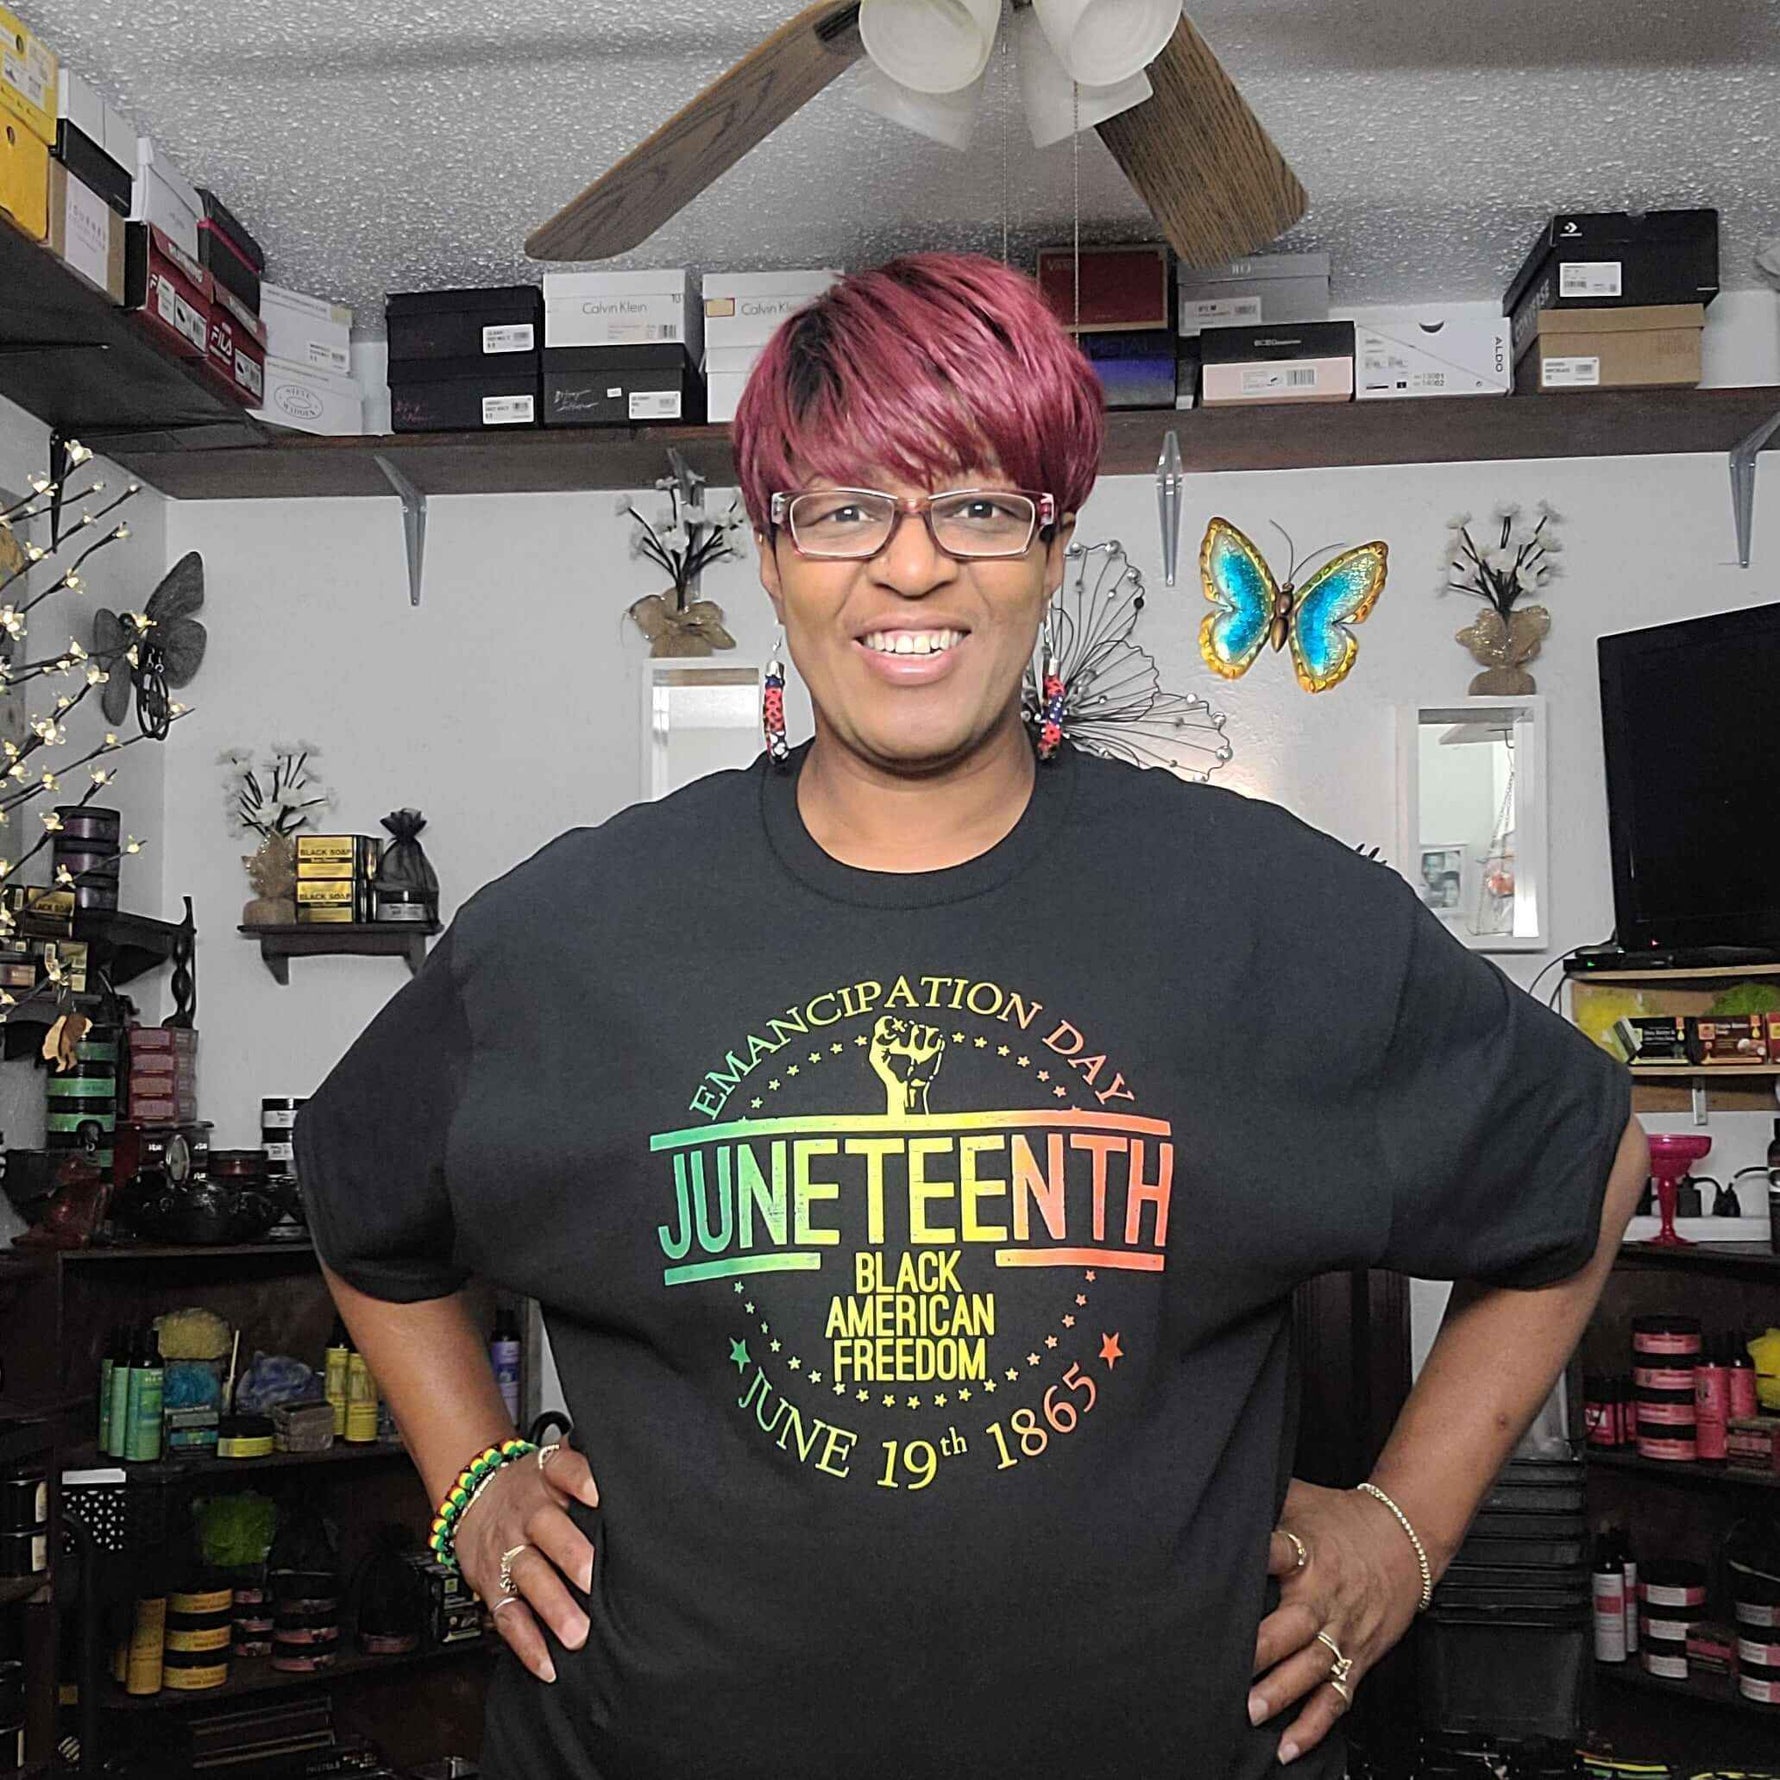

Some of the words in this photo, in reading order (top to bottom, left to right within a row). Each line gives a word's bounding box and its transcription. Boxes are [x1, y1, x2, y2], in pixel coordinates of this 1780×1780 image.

[582, 301, 618, 315] Calvin
[619, 301, 648, 314] Klein
[741, 302, 777, 316] Calvin
[211, 325, 232, 356] FILA
[1494, 336, 1504, 373] ALDO
[299, 893, 328, 901] BLACK
[689, 975, 1043, 1121] EMANCIPATION
[1041, 1019, 1136, 1106] DAY
[657, 1132, 1174, 1260] JUNETEENTH
[855, 1249, 963, 1295] BLACK
[824, 1292, 995, 1339] AMERICAN
[833, 1337, 986, 1383] FREEDOM
[738, 1366, 858, 1478] JUNE
[876, 1426, 968, 1490] 19th
[985, 1361, 1097, 1470] 1865
